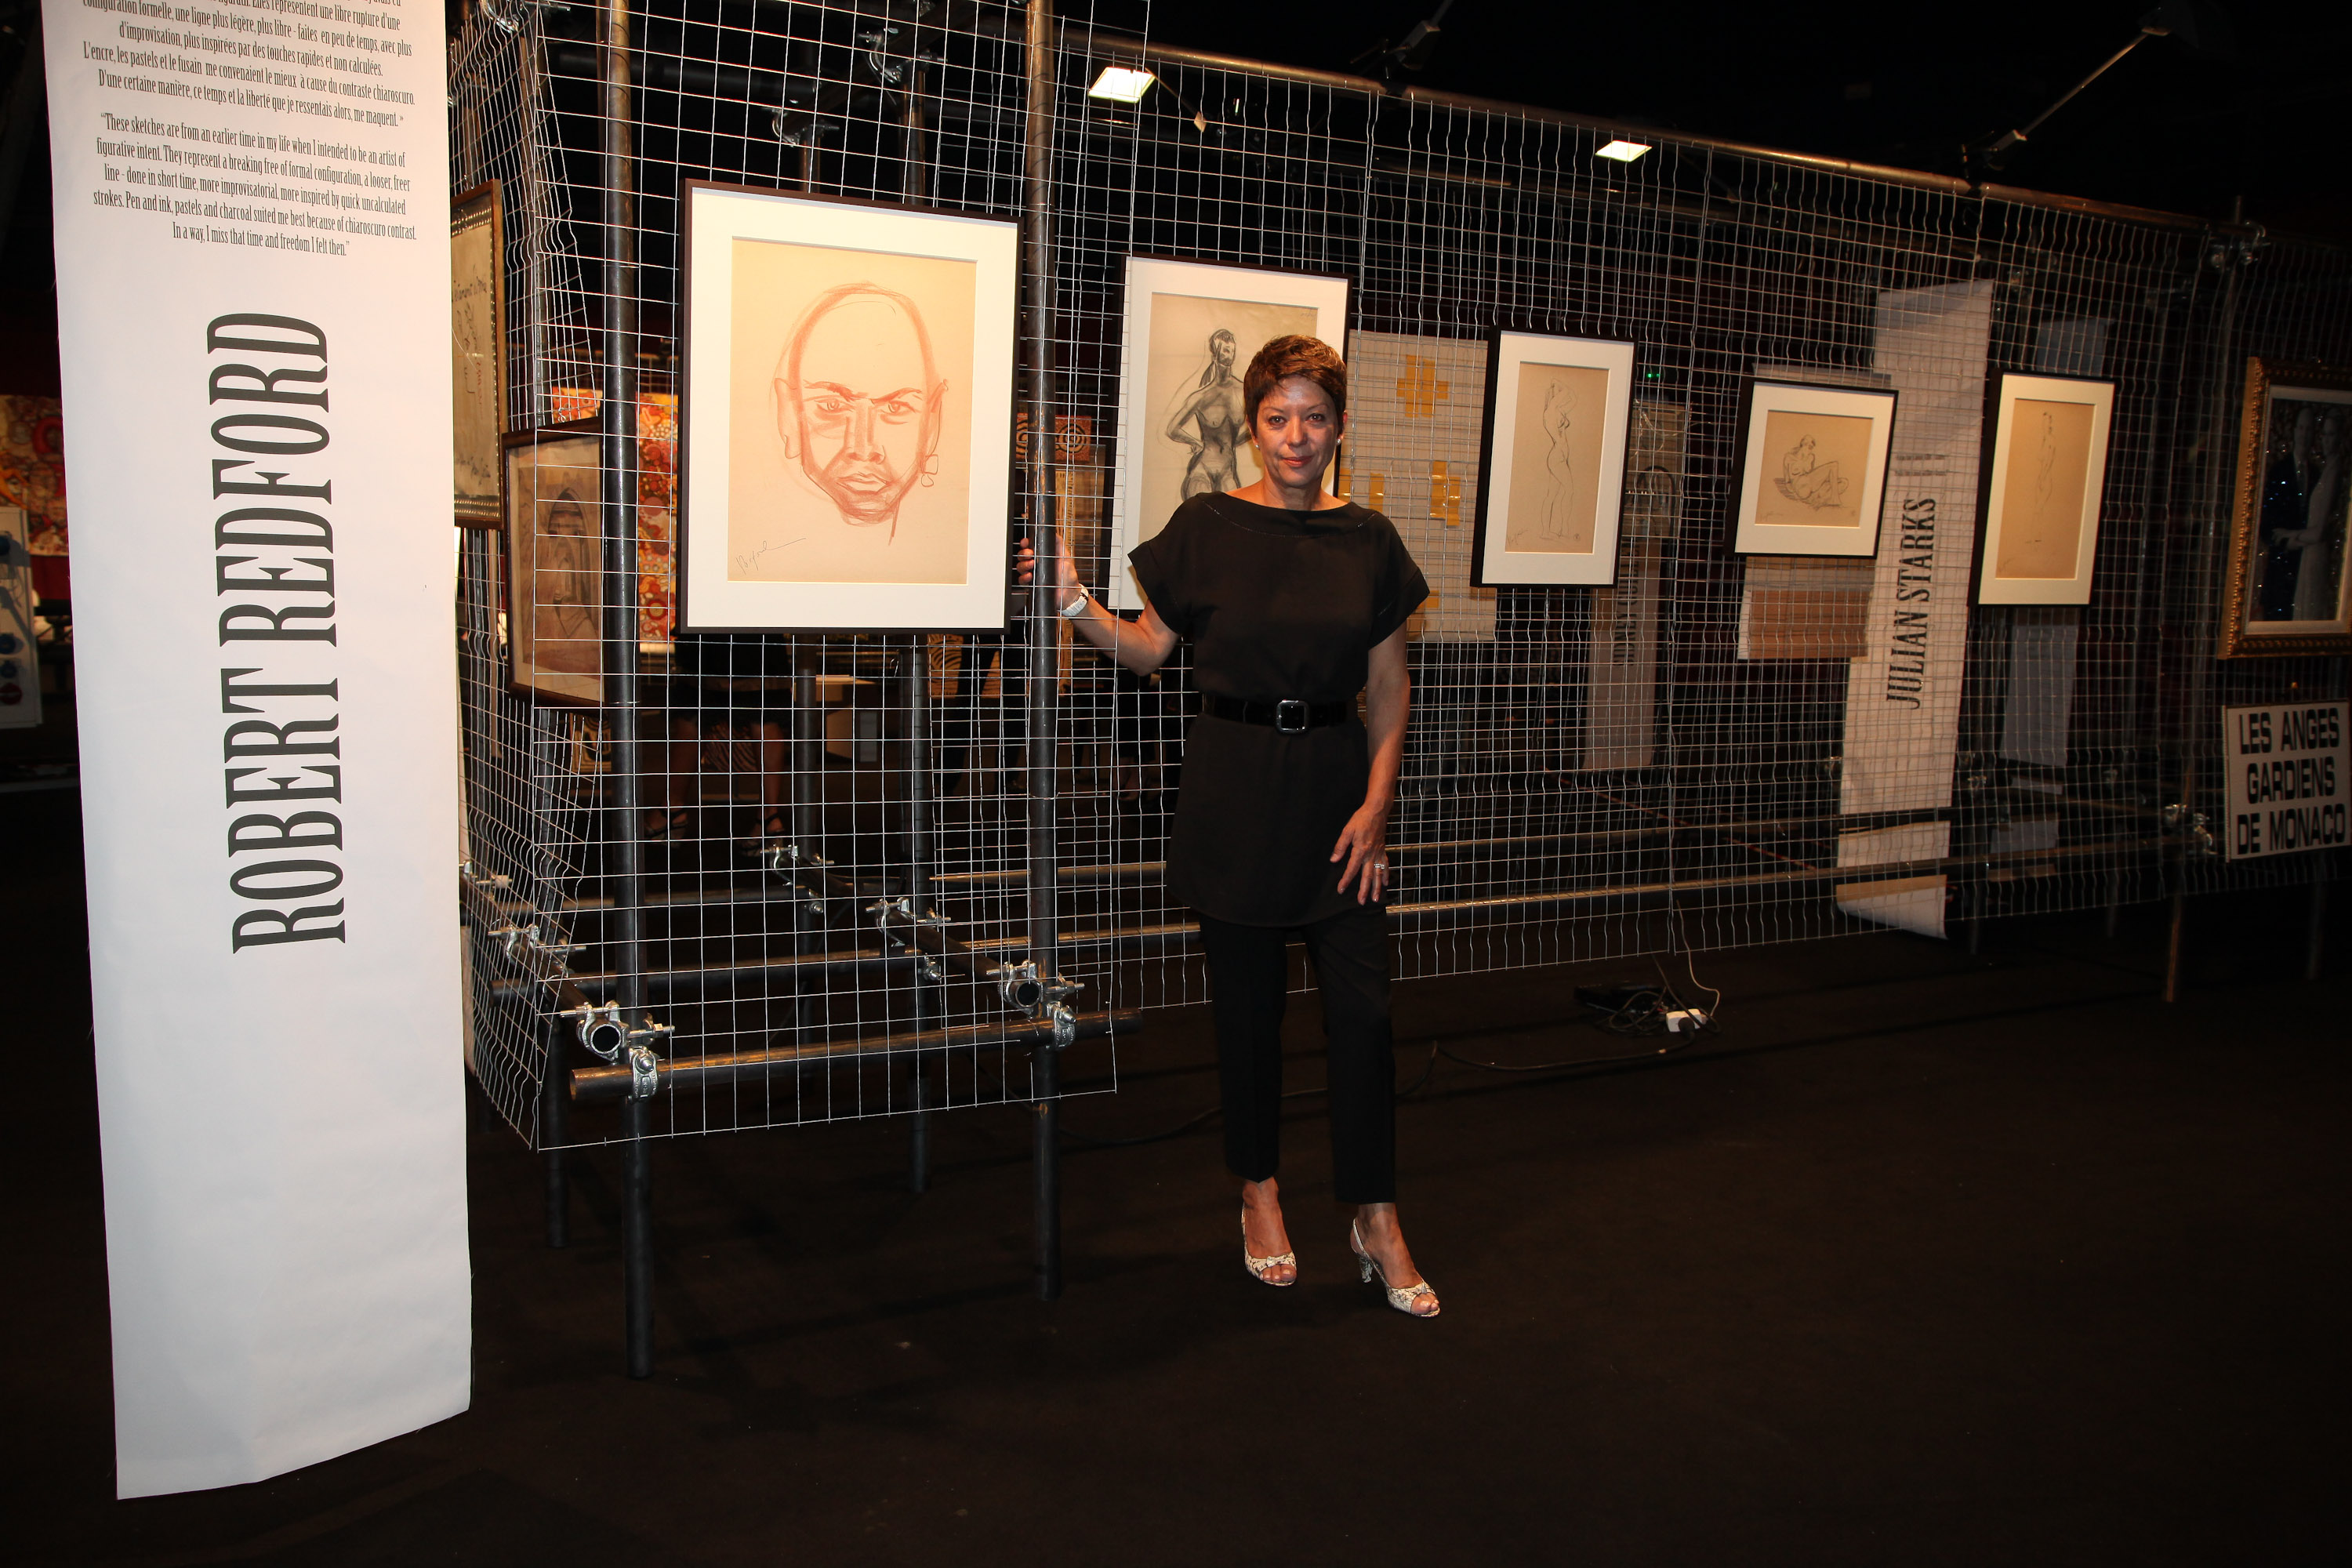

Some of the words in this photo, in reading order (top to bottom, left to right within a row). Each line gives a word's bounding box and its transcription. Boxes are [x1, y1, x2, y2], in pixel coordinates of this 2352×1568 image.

[175, 8, 191, 22] une
[191, 6, 211, 27] ligne
[212, 10, 229, 29] plus
[257, 17, 273, 36] plus
[274, 19, 292, 38] libre
[298, 24, 318, 42] faites
[321, 31, 330, 44] en
[332, 32, 345, 48] peu
[347, 31, 354, 48] de
[381, 41, 395, 53] avec
[397, 39, 412, 57] plus
[320, 5, 333, 20] une
[334, 4, 351, 23] libre
[353, 11, 379, 27] rupture
[381, 13, 400, 31] d'une
[117, 45, 129, 64] les
[130, 51, 158, 68] pastels
[160, 54, 168, 69] et
[169, 53, 176, 71] le
[177, 55, 202, 74] fusain
[205, 63, 218, 77] me
[220, 65, 264, 83] convenaient
[265, 67, 272, 84] le
[274, 70, 297, 88] mieux
[300, 74, 305, 89] à
[307, 78, 326, 92] cause
[328, 77, 338, 94] du
[339, 82, 372, 99] contraste
[183, 31, 201, 50] plus
[201, 33, 237, 54] inspirées
[238, 42, 251, 58] par
[252, 41, 265, 59] des
[267, 44, 296, 63] touches
[297, 49, 324, 67] rapides
[325, 54, 332, 69] et
[333, 57, 347, 71] non
[99, 69, 122, 89] D'une
[124, 75, 157, 93] certaine
[194, 86, 202, 99] ce
[204, 85, 227, 105] temps
[228, 89, 236, 104] et
[237, 88, 245, 105] la
[245, 89, 270, 108] liberté
[272, 97, 285, 112] que
[287, 96, 294, 114] je
[296, 100, 332, 117] ressentais
[354, 109, 364, 122] me
[97, 137, 135, 158] figurative
[163, 144, 182, 166] They
[184, 151, 221, 168] represent
[223, 157, 227, 169] a
[228, 153, 262, 176] breaking
[264, 158, 278, 175] free
[281, 160, 288, 176] of
[289, 161, 313, 180] formal
[365, 175, 368, 187] a
[394, 174, 410, 191] freer
[132, 116, 165, 136] sketches
[166, 124, 180, 138] are
[181, 122, 199, 141] from
[201, 129, 211, 142] an
[212, 128, 238, 146] earlier
[239, 130, 256, 147] time
[257, 132, 265, 149] in
[267, 137, 277, 153] my
[279, 135, 290, 152] life
[292, 137, 311, 155] when
[313, 140, 316, 155] I
[318, 140, 348, 160] intended
[350, 146, 357, 162] to
[358, 146, 367, 162] be
[368, 151, 377, 164] an
[379, 151, 397, 166] artist
[398, 152, 405, 168] of
[104, 163, 119, 181] line
[127, 166, 147, 184] done
[147, 168, 156, 186] in
[158, 169, 178, 188] short
[199, 179, 220, 193] more
[281, 188, 299, 202] more
[301, 187, 329, 207] inspired
[331, 191, 339, 209] by
[341, 193, 361, 210] quick
[362, 196, 406, 215] uncalculated
[125, 191, 141, 209] Pen
[143, 194, 158, 211] and
[175, 198, 202, 216] pastels
[204, 201, 218, 218] and
[220, 202, 252, 221] charcoal
[254, 206, 276, 223] suited
[278, 212, 289, 225] me
[290, 209, 306, 227] best
[307, 212, 336, 230] because
[337, 216, 343, 232] of
[345, 216, 386, 237] chiaroscuro
[172, 221, 181, 238] In
[183, 227, 188, 239] a
[205, 225, 210, 241] I
[211, 227, 228, 243] miss
[230, 227, 245, 245] that
[247, 230, 263, 246] time
[265, 232, 279, 249] and
[281, 233, 310, 252] freedom
[311, 237, 314, 252] I
[316, 237, 328, 254] felt
[206, 313, 337, 648] REDFORD
[1896, 498, 1936, 601] STARKS
[1886, 610, 1929, 710] JULIAN
[2239, 712, 2272, 754] LES
[2281, 707, 2340, 751] ANGES
[2247, 756, 2336, 804] GARDIENS
[220, 668, 346, 954] ROBERT
[2237, 812, 2261, 855] DE
[2270, 803, 2346, 851] MONACO
